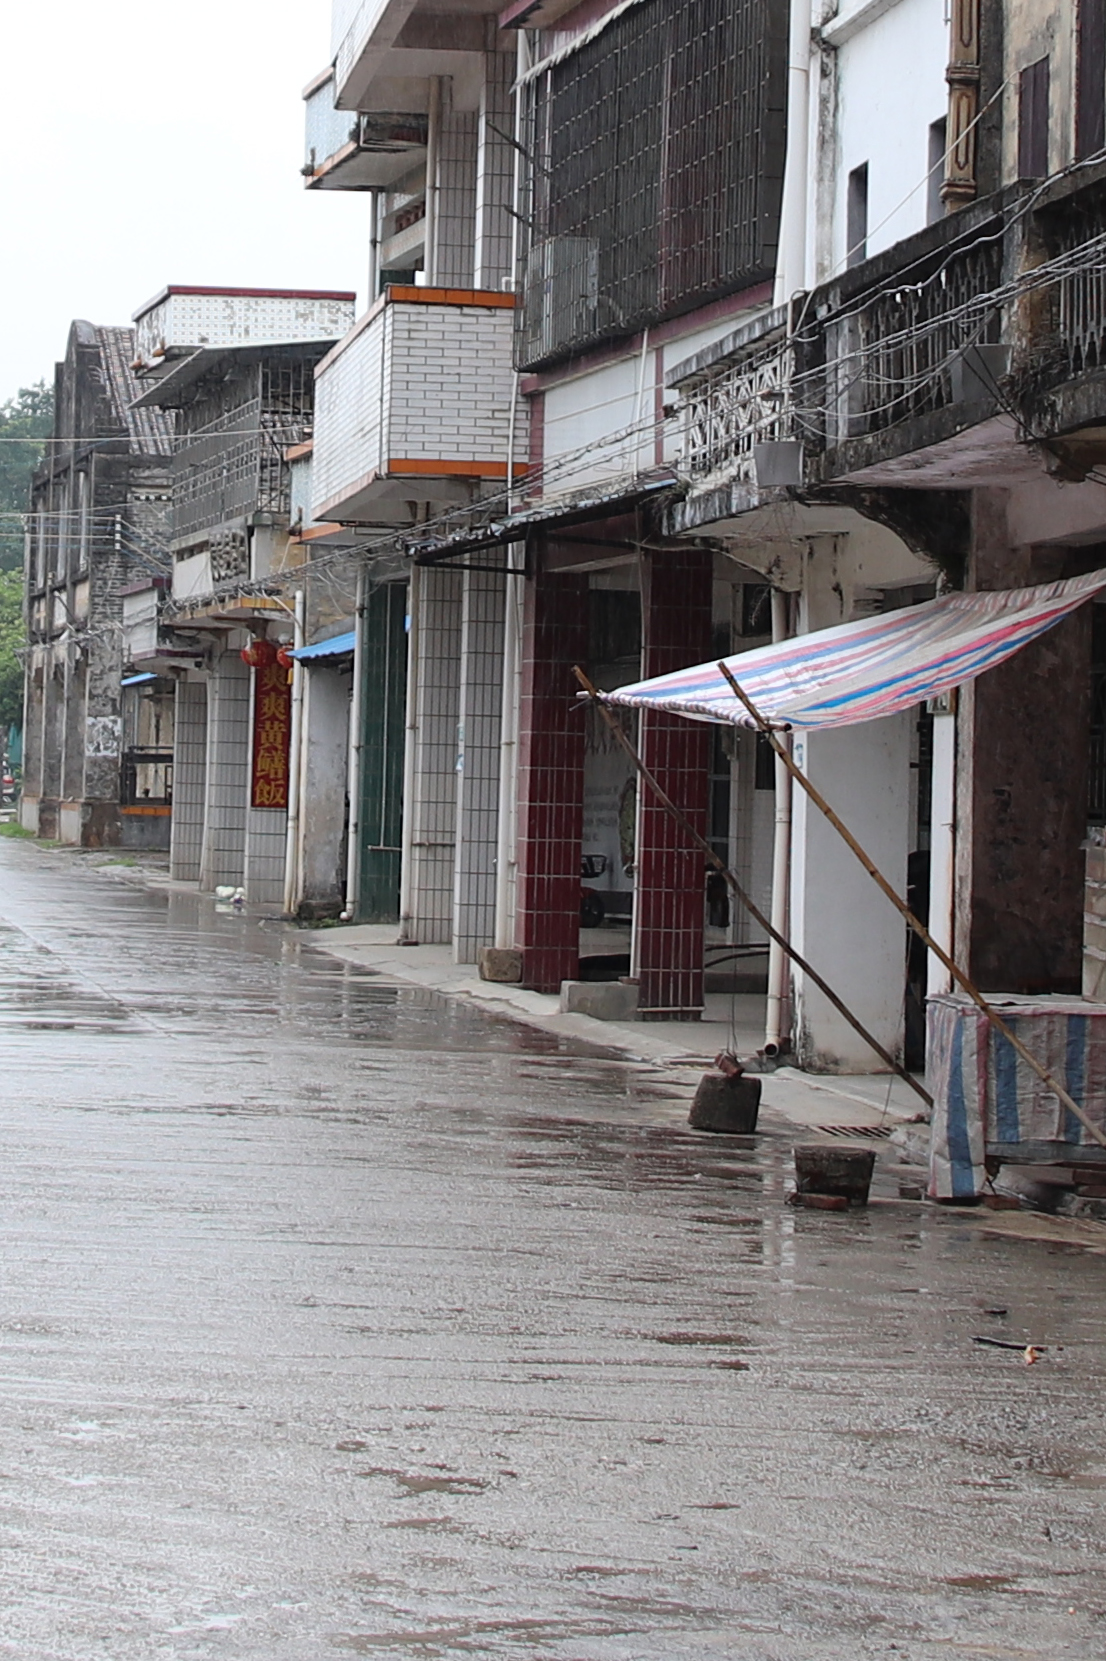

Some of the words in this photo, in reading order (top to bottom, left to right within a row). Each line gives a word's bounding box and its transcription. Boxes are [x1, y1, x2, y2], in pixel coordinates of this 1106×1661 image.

[255, 663, 287, 805] 爽爽黄鳝飯
